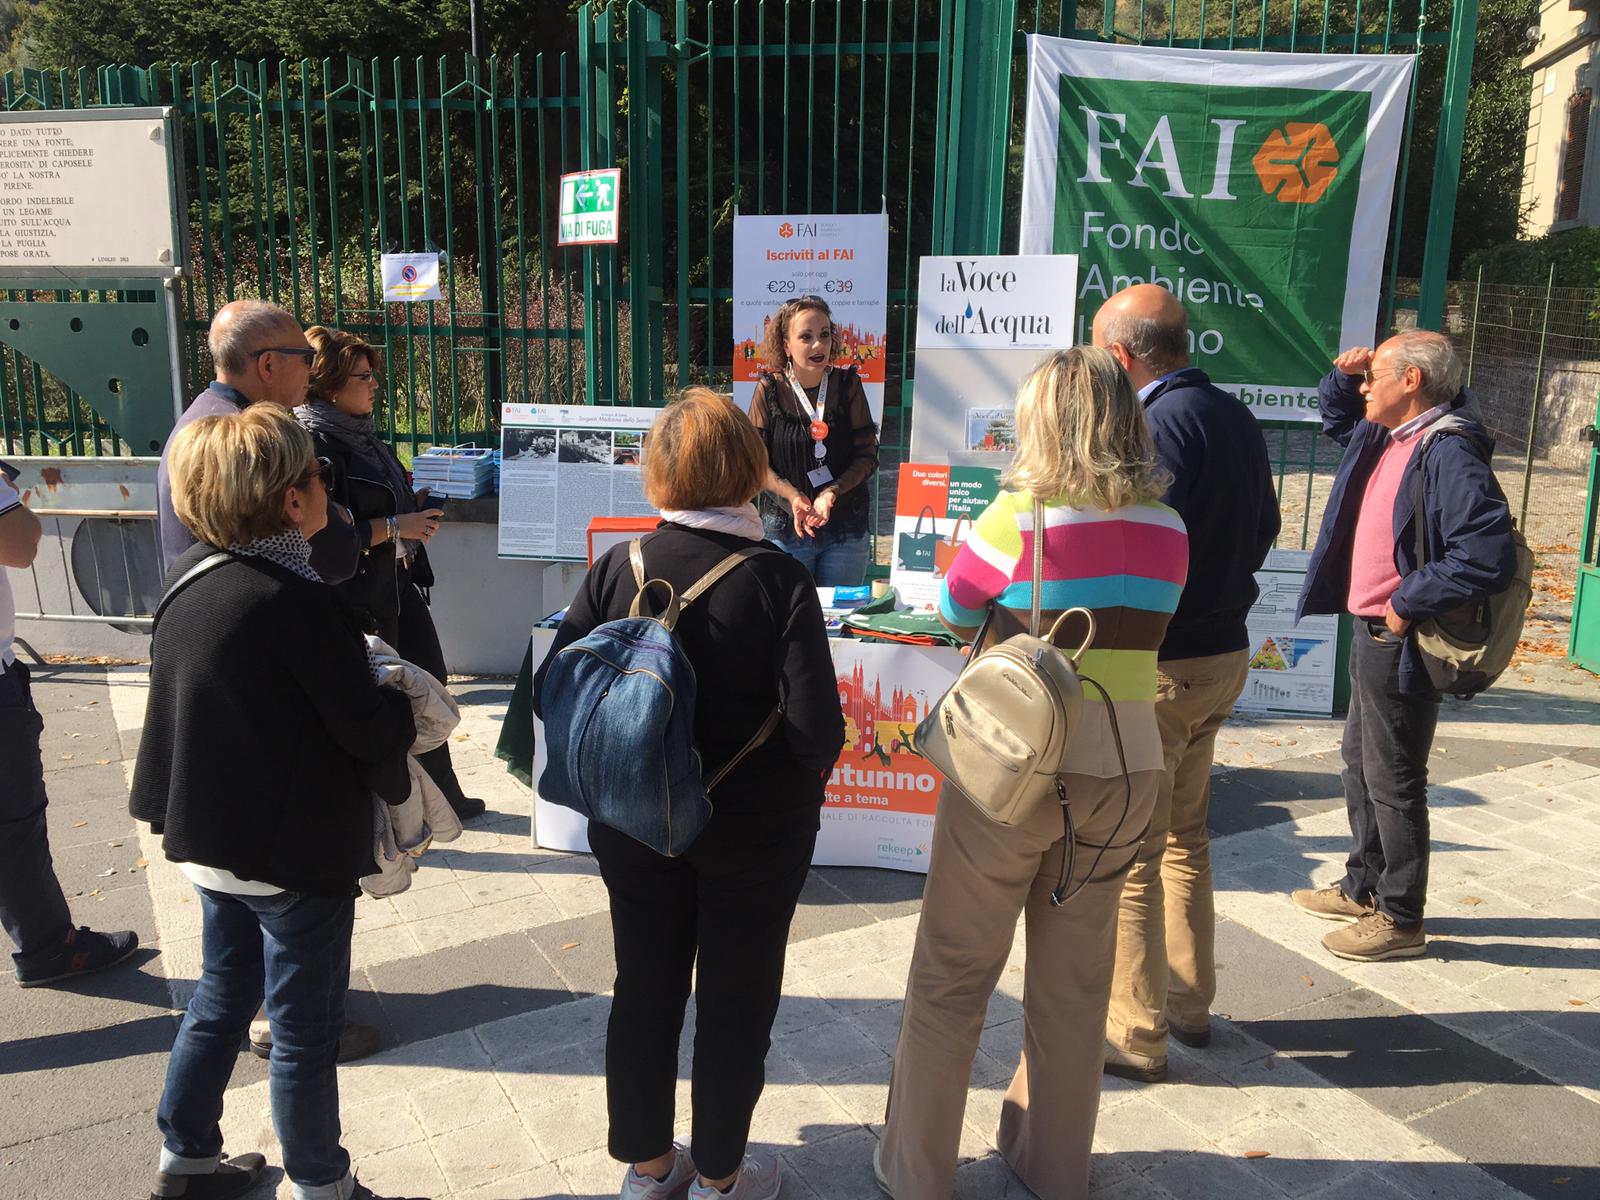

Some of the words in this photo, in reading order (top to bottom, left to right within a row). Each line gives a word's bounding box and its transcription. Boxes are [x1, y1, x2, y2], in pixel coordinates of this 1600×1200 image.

[10, 128, 32, 137] DATO
[36, 127, 63, 136] TUTTO
[22, 139, 41, 147] UNA
[45, 138, 74, 147] FONTE,
[0, 149, 49, 158] PLICEMENTE
[53, 149, 95, 157] CHIEDERE
[1076, 105, 1247, 201] FAI
[0, 160, 35, 169] EROSITA'
[38, 160, 48, 169] DI
[52, 159, 93, 168] CAPOSELE
[0, 171, 9, 180] O'
[13, 171, 25, 180] LA
[29, 171, 61, 179] NOSTRA
[0, 197, 22, 206] ORDO
[27, 196, 75, 205] INDELEBILE
[3, 208, 15, 216] UN
[19, 207, 52, 216] LEGAME
[21, 218, 72, 228] SULL'ACQUA
[0, 229, 11, 237] LA
[14, 229, 57, 238] GIUSTIZIA,
[560, 221, 573, 239] VIA
[574, 221, 583, 236] DI
[585, 219, 613, 236] FUGA
[797, 223, 817, 238] FAI
[1081, 210, 1206, 255] Fondo
[2, 239, 13, 248] LA
[17, 239, 47, 248] PUGLIA
[0, 250, 19, 258] POSE
[23, 250, 51, 258] GRATA.
[766, 248, 815, 261] Iscriviti
[817, 248, 830, 261] al
[833, 248, 854, 261] FAI
[940, 272, 956, 292] la
[955, 261, 1017, 293] Voce
[767, 280, 796, 293] €29
[823, 279, 854, 294] €39
[1230, 387, 1320, 409] biente
[912, 470, 926, 478] Due
[927, 471, 948, 479] colori
[948, 497, 962, 505] per
[962, 497, 990, 506] aiutare
[947, 504, 971, 512] l'Italia
[826, 763, 936, 792] utunno
[825, 791, 841, 803] ite
[844, 794, 852, 803] a
[856, 793, 889, 806] tema
[821, 812, 845, 821] NALE
[847, 813, 858, 821] DI
[861, 814, 912, 826] RACCOLTA
[916, 819, 934, 828] FON
[876, 842, 914, 857] rekeep
